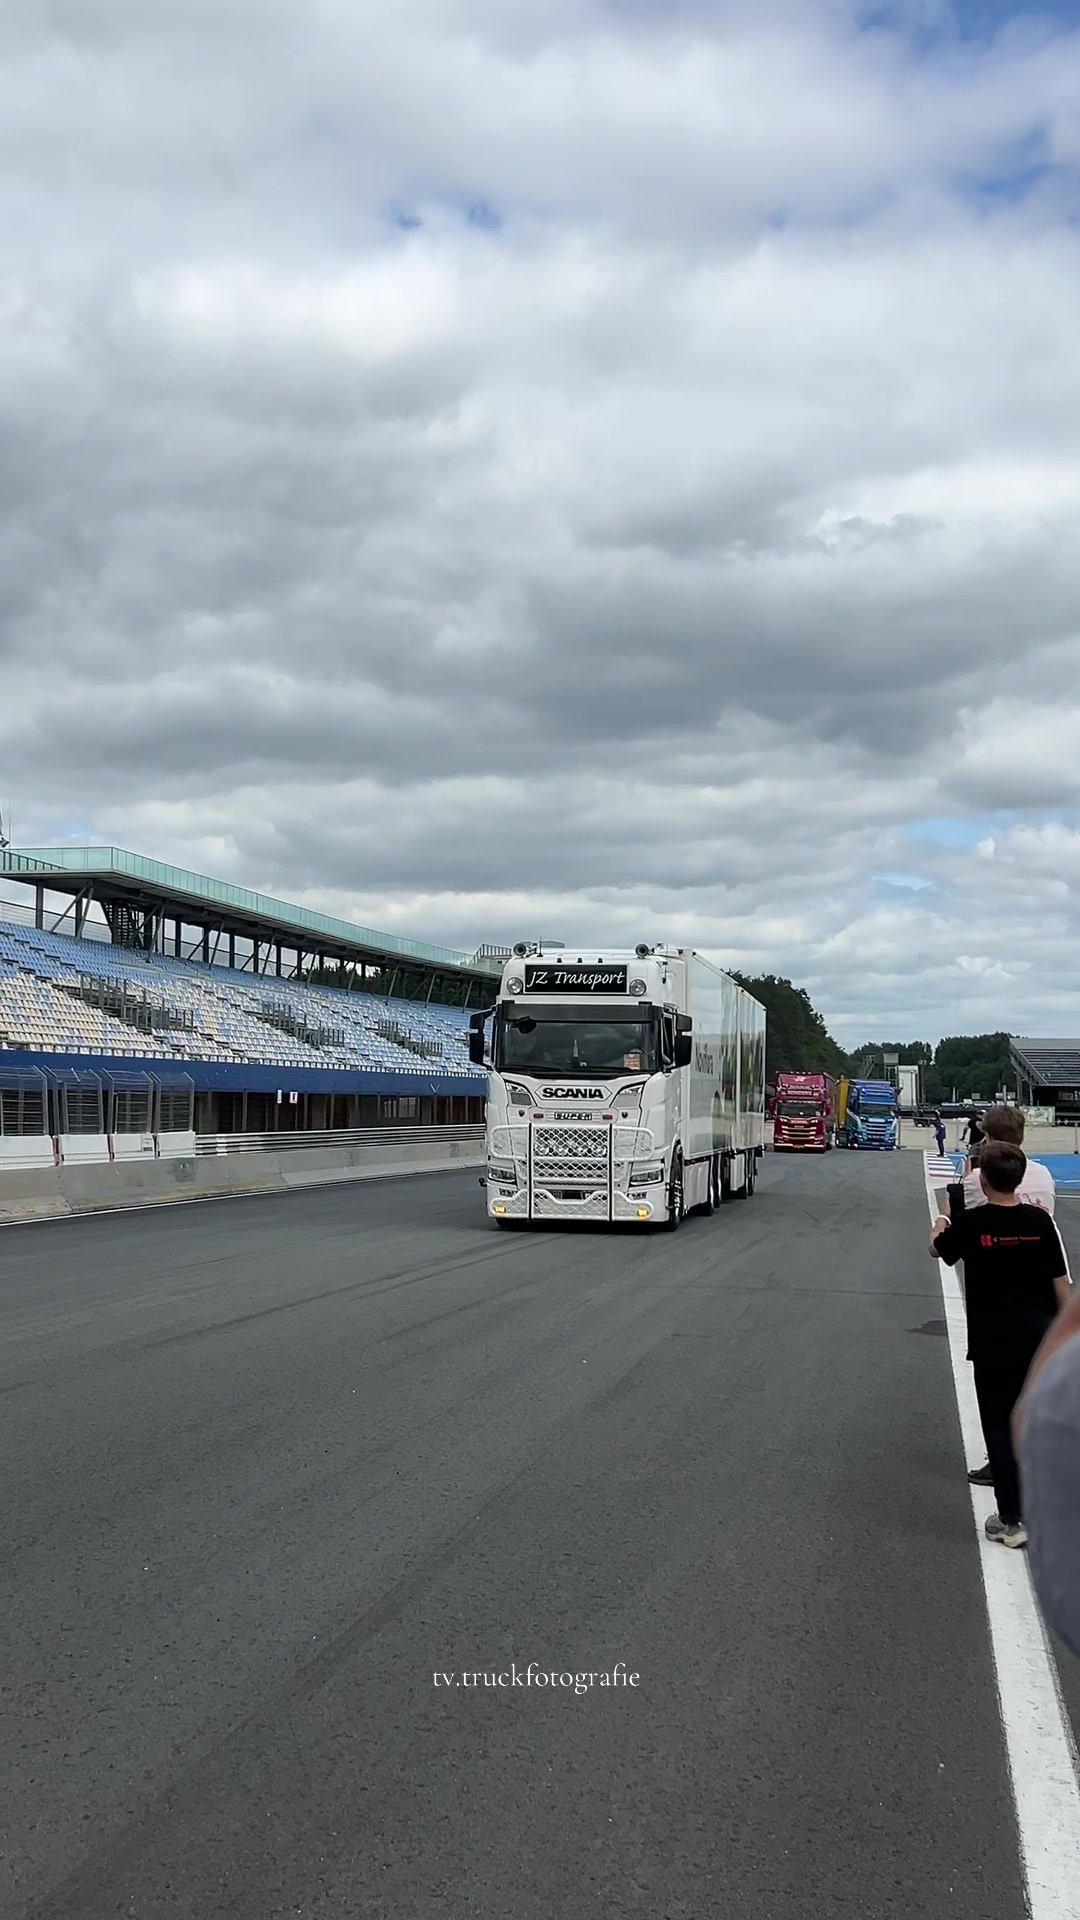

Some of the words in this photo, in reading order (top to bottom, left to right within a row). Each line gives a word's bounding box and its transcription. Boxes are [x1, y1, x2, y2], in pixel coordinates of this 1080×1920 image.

[526, 971, 548, 988] JZ
[554, 971, 625, 990] Transport
[542, 1087, 604, 1099] SCANIA
